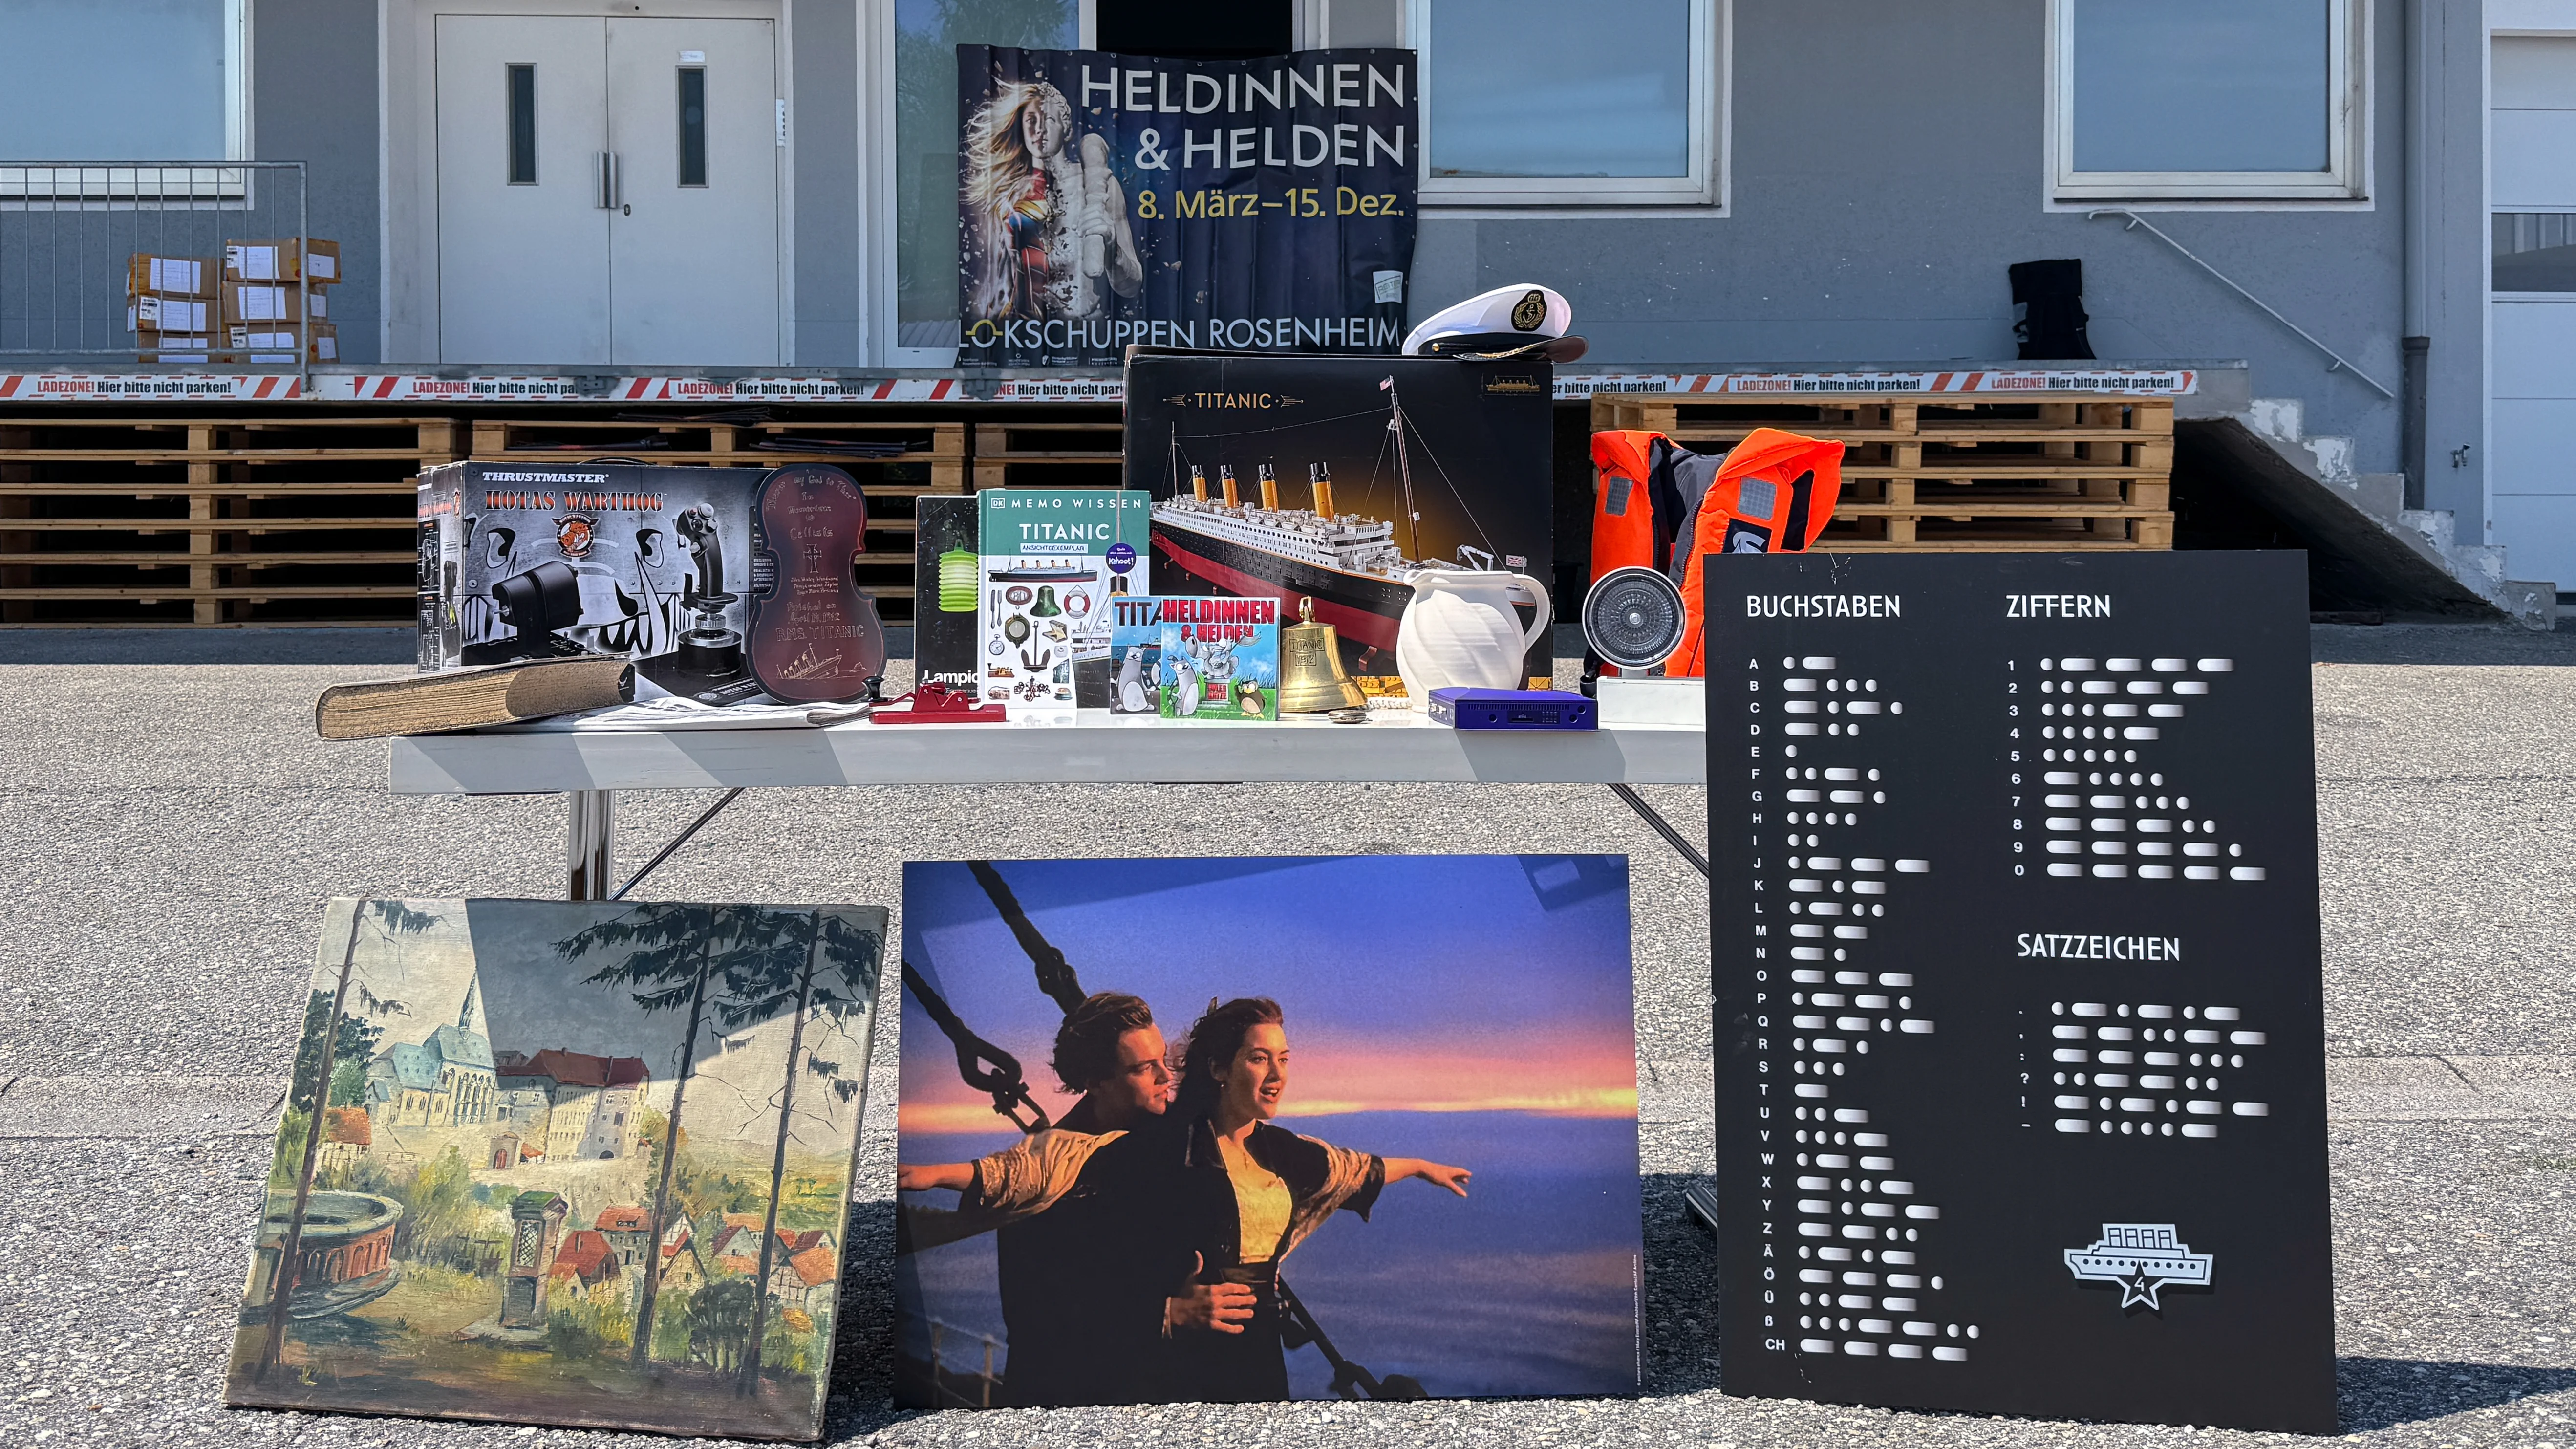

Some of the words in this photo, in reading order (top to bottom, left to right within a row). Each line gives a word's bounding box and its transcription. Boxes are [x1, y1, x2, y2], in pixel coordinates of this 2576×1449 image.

[1082, 64, 1405, 114] HELDINNEN
[1135, 128, 1171, 171] &
[1183, 123, 1405, 170] HELDEN
[1138, 190, 1165, 219] 8.
[1336, 186, 1405, 217] Dez.
[958, 318, 1195, 350] LOKSCHUPPEN
[1209, 317, 1400, 348] ROSENHEIM
[38, 381, 95, 393] LADEZONE!
[98, 381, 122, 393] Hier
[125, 381, 151, 393] bitte
[154, 382, 184, 393] nicht
[187, 382, 231, 394] parken!
[413, 382, 470, 394] LADEZONE!
[472, 382, 496, 394] Hier
[499, 382, 526, 394] bitte
[528, 383, 558, 394] nicht
[678, 383, 733, 394] LADEZONE!
[736, 383, 759, 394] Hier
[762, 383, 787, 394] bitte
[790, 383, 818, 395] nicht
[821, 384, 864, 395] parken!
[1565, 383, 1590, 394] bitte
[1593, 382, 1621, 393] nicht
[1624, 381, 1666, 393] parken!
[1737, 380, 1791, 391] LADEZONE!
[1794, 380, 1817, 390] Hier
[1819, 380, 1845, 390] bitte
[1847, 379, 1875, 390] nicht
[1878, 379, 1920, 391] parken!
[1991, 378, 2046, 389] LADEZONE!
[2048, 377, 2071, 388] Hier
[2074, 377, 2099, 389] bitte
[2101, 377, 2129, 388] nicht
[2132, 377, 2174, 389] parken!
[1018, 384, 1041, 395] Hier
[1043, 384, 1068, 395] bitte
[1071, 384, 1099, 395] nicht
[1195, 393, 1270, 408] TITANIC
[485, 490, 555, 511] HOTAS
[563, 491, 663, 512] WARTHOG
[1011, 498, 1062, 508] MEMO
[1073, 498, 1141, 509] WISSEN
[1019, 523, 1110, 540] TITANIC
[1747, 594, 1900, 618] BUCHSTABEN
[2006, 594, 2111, 618] ZIFFERN
[1163, 600, 1275, 625] HELDINNEN
[809, 625, 864, 639] TITANIC
[1181, 624, 1191, 642] &
[1197, 624, 1254, 643] HELDEN
[1292, 640, 1322, 649] TITANIC
[1749, 658, 1759, 670] A
[2008, 660, 2014, 671] 1
[1749, 680, 1759, 691] B
[2008, 682, 2018, 694] 2
[1750, 702, 1760, 714] C
[2009, 705, 2018, 716] 3
[1750, 724, 1760, 735] D
[2010, 728, 2020, 739] 4
[1751, 746, 1760, 757] E
[2010, 750, 2020, 762] 5
[1751, 768, 1760, 779] F
[2011, 773, 2021, 785] 6
[1752, 790, 1762, 802] G
[2012, 796, 2021, 807] 7
[1752, 813, 1762, 824] H
[2013, 819, 2023, 830] 8
[1753, 835, 1757, 846] I
[2013, 842, 2023, 853] 9
[1753, 857, 1761, 868] J
[2014, 864, 2024, 876] 0
[1754, 880, 1764, 891] K
[1755, 902, 1763, 913] L
[1755, 925, 1767, 936] M
[1756, 947, 1766, 959] N
[2017, 933, 2180, 961] SATZZEICHEN
[1756, 970, 1767, 981] O
[1757, 993, 1766, 1004] P
[1758, 1015, 1768, 1027] Q
[1758, 1038, 1768, 1050] R
[1759, 1061, 1768, 1073] S
[2020, 1072, 2029, 1084] ?
[1759, 1084, 1769, 1096] T
[2021, 1096, 2026, 1107] !
[1760, 1107, 1770, 1119] U
[1760, 1130, 1770, 1142] V
[1761, 1153, 1775, 1165] W
[1761, 1176, 1772, 1189] X
[1762, 1199, 1772, 1211] Y
[1763, 1222, 1772, 1234] Z
[1763, 1243, 1774, 1258] Ä
[1763, 1266, 1775, 1280] Ö
[2134, 1276, 2145, 1292] 4
[1764, 1290, 1774, 1304] Ü
[1765, 1338, 1785, 1351] CH
